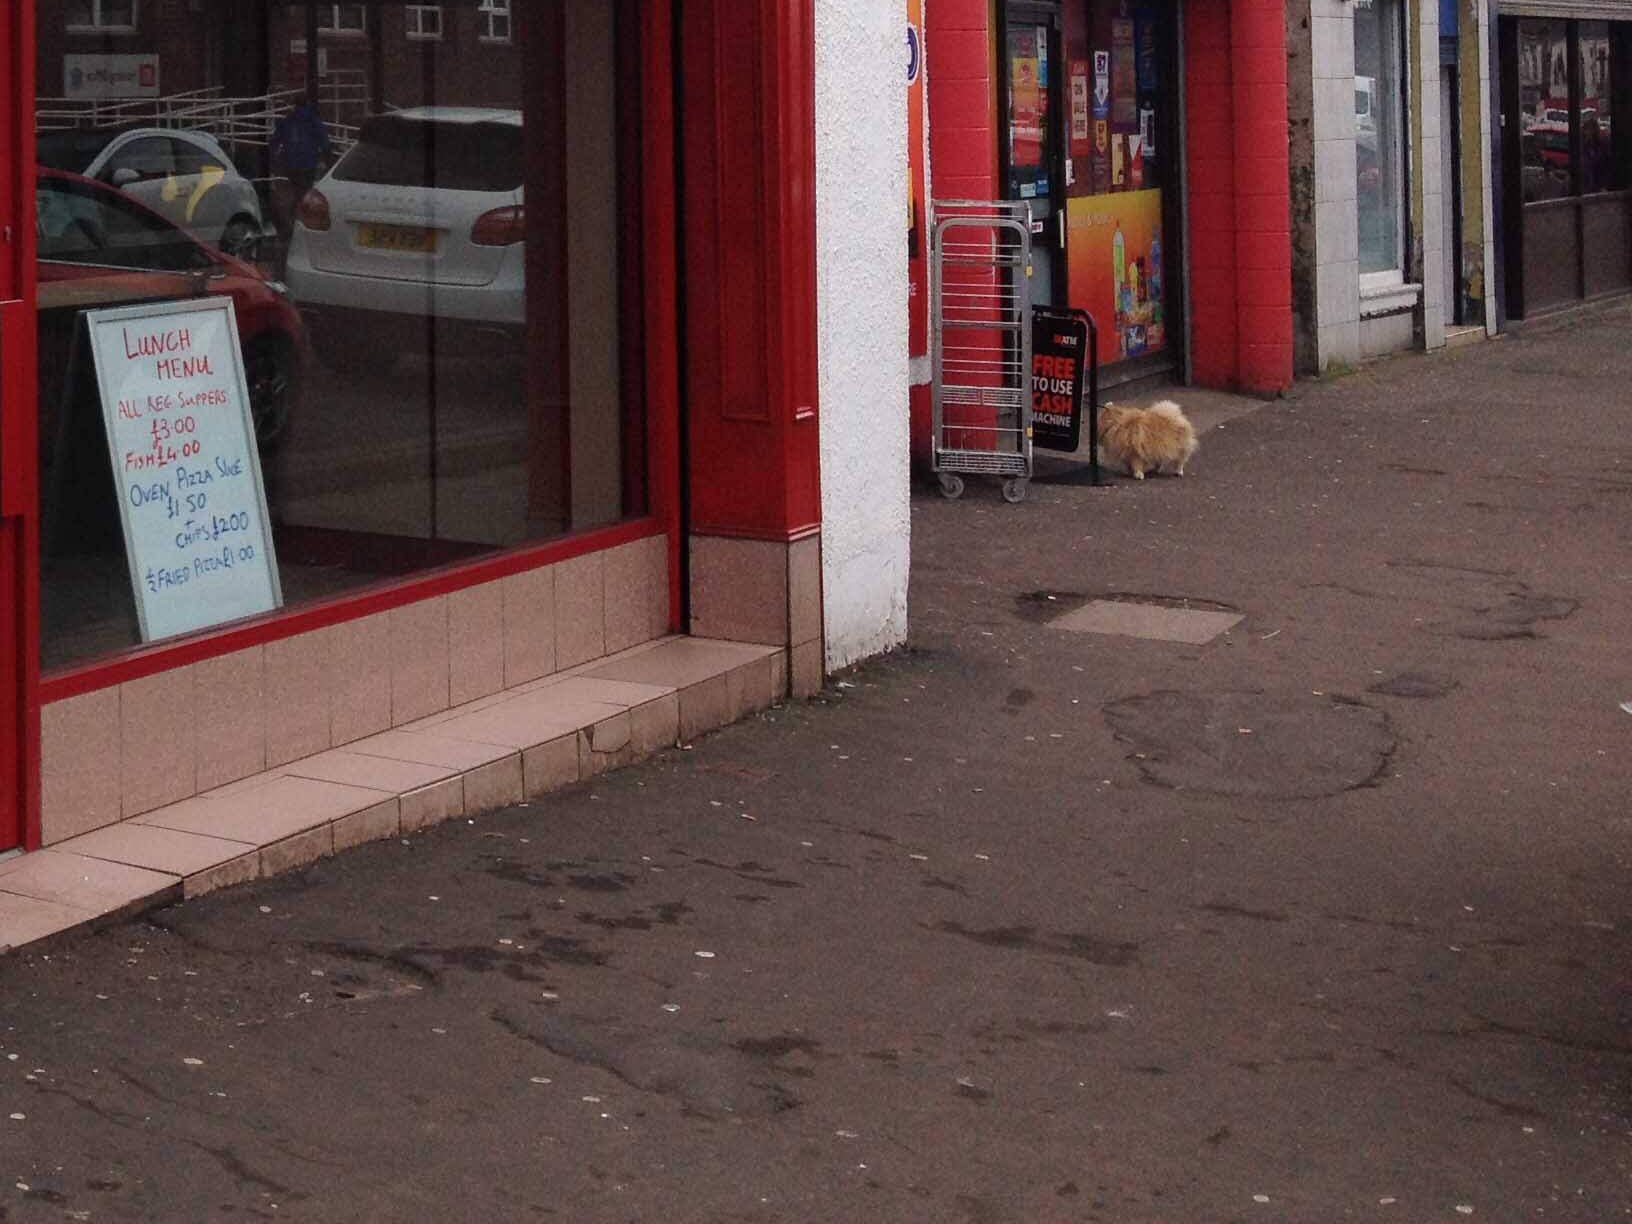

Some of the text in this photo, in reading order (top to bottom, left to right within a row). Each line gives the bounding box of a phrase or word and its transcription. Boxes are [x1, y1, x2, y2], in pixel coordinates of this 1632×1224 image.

[123, 327, 191, 360] LUNCH
[156, 355, 214, 380] MENU
[1032, 353, 1075, 381] FREE
[1031, 376, 1073, 395] TO USE
[118, 400, 142, 420] ALL
[1030, 392, 1072, 416] CASH
[130, 480, 170, 507] OVEN
[176, 467, 213, 489] PIZZA
